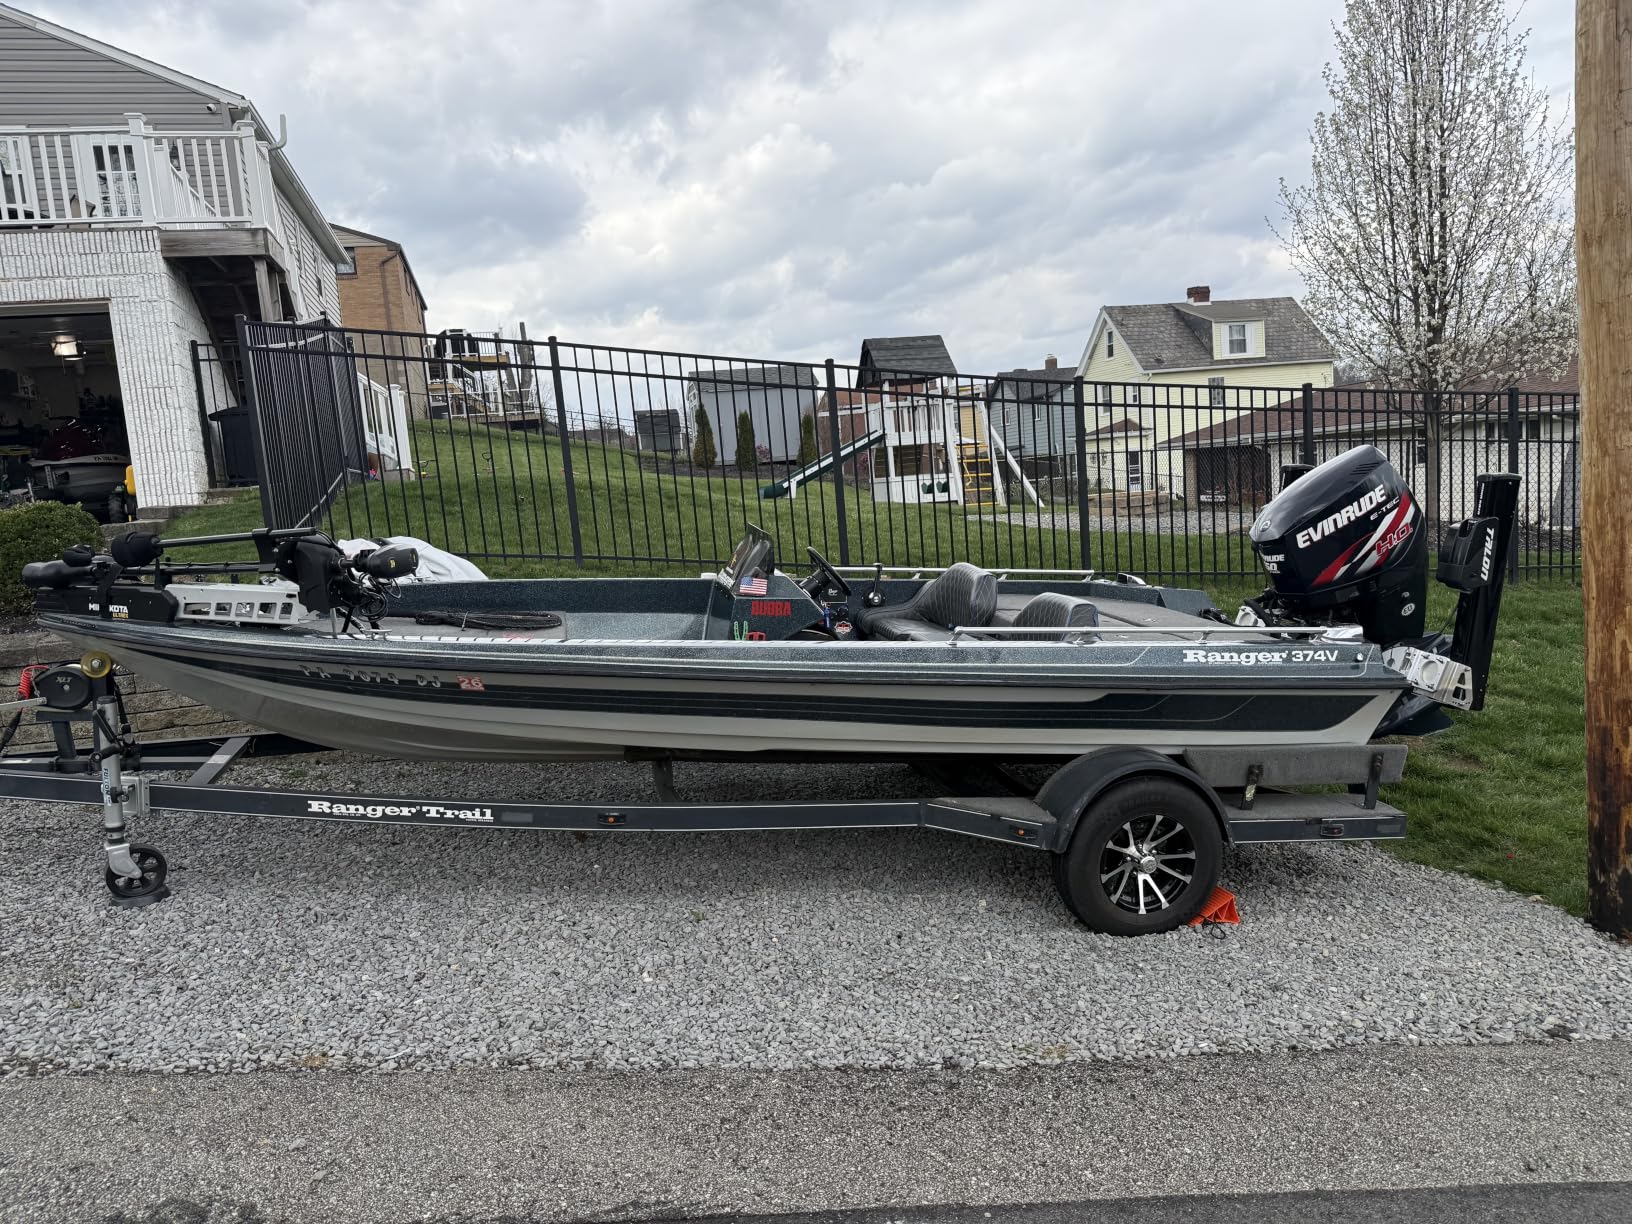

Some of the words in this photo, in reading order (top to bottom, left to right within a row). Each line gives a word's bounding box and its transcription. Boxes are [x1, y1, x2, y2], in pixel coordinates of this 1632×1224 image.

[1296, 483, 1387, 549] EVINRUDE
[1370, 496, 1400, 520] E-TEC
[1480, 527, 1495, 581] TALON
[109, 604, 128, 613] KOTA
[1182, 649, 1287, 665] Ranger
[1291, 650, 1339, 662] 374V
[459, 677, 482, 689] 26
[307, 800, 417, 818] Ranger
[422, 806, 494, 820] Trail
